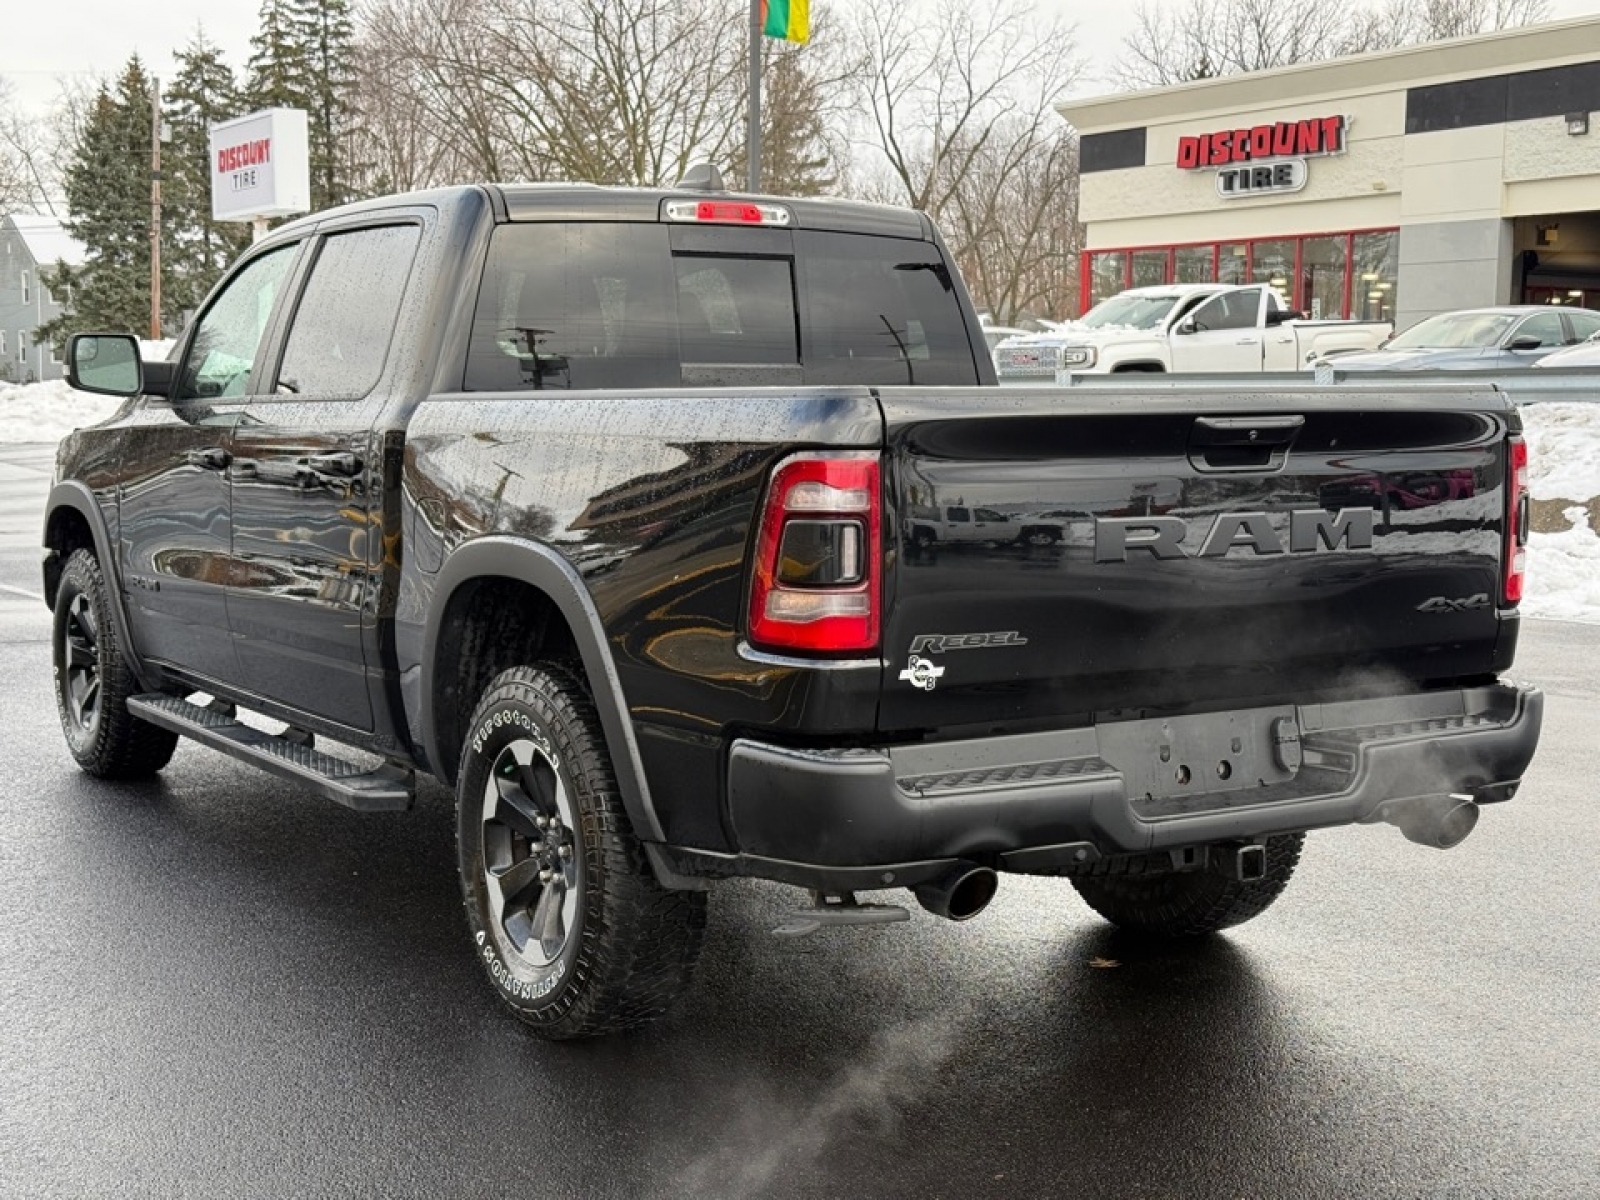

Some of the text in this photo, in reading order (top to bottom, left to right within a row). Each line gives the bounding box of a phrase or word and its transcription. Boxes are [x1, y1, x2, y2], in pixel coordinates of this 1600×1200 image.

[217, 138, 271, 173] DISCOUNT
[1177, 114, 1344, 169] DISCOUNT
[232, 170, 256, 189] TIRE
[1219, 164, 1293, 191] TIRE
[1095, 507, 1374, 563] RAM
[908, 631, 1028, 654] REBEL
